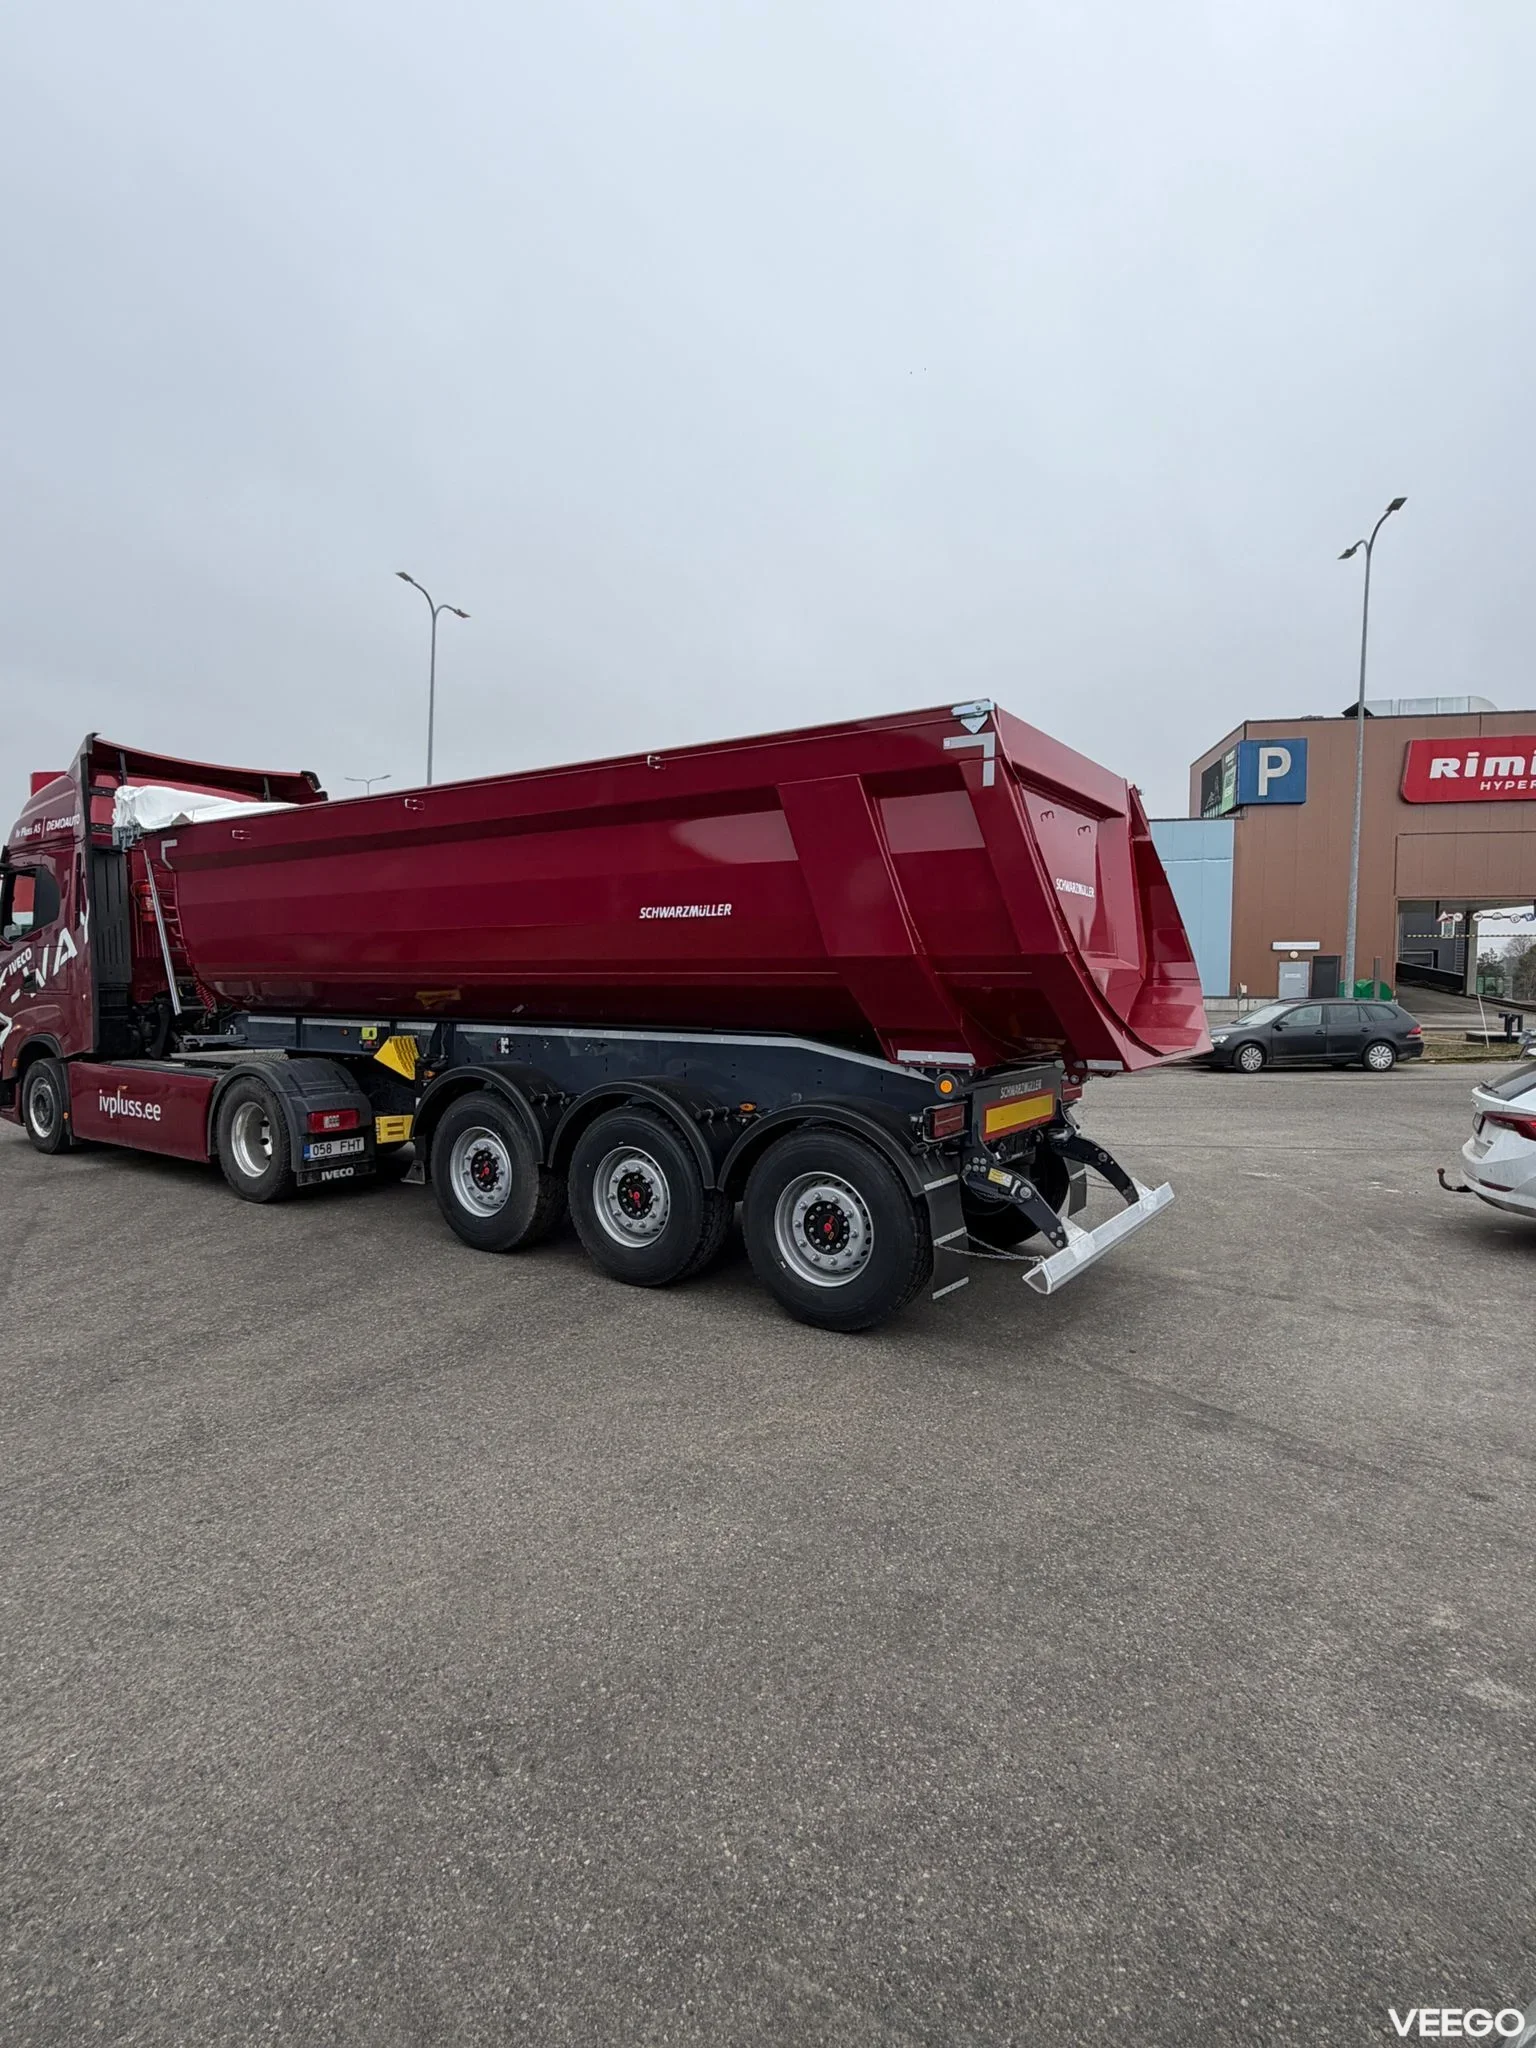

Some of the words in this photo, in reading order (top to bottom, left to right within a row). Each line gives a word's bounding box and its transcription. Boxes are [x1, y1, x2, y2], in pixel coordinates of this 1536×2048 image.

[1258, 747, 1291, 796] P
[639, 903, 732, 919] SCHWARZMÜLLER
[8, 947, 32, 976] IVECO
[99, 1089, 161, 1121] ivpluss.ee
[312, 1143, 332, 1156] 058
[340, 1139, 362, 1152] FHT
[321, 1167, 354, 1181] IVECO
